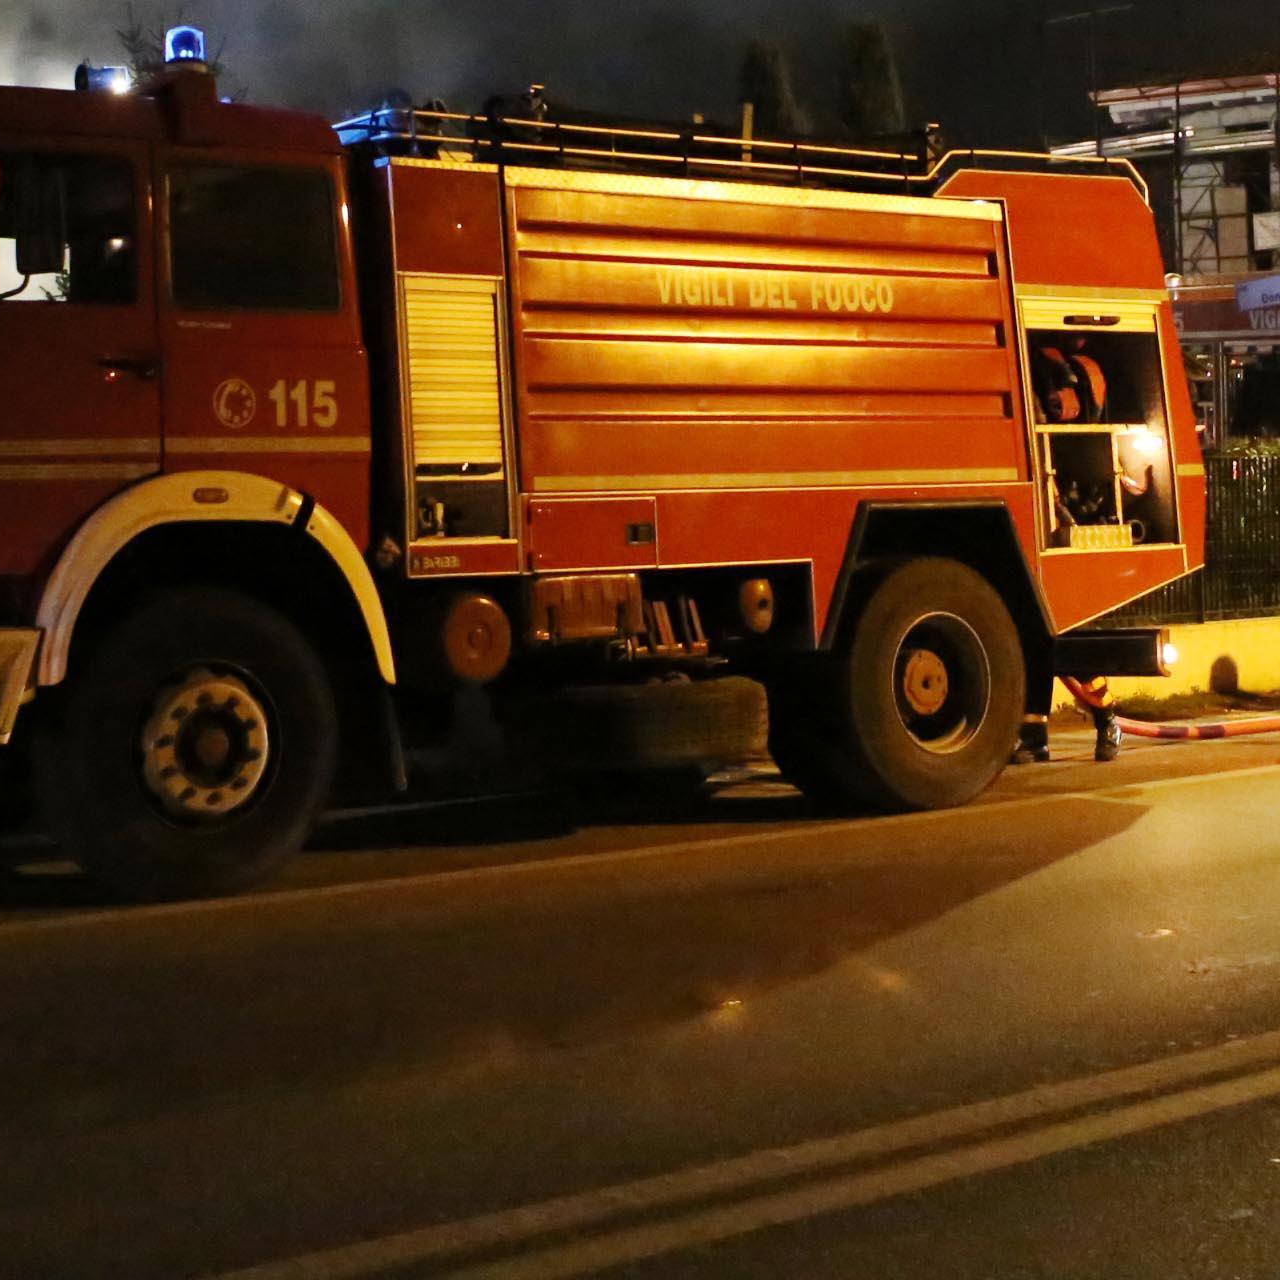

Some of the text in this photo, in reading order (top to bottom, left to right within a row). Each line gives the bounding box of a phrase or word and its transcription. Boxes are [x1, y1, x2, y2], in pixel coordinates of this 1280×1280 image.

[656, 269, 894, 314] VIGILI DEL FUOCO
[268, 379, 339, 428] 115
